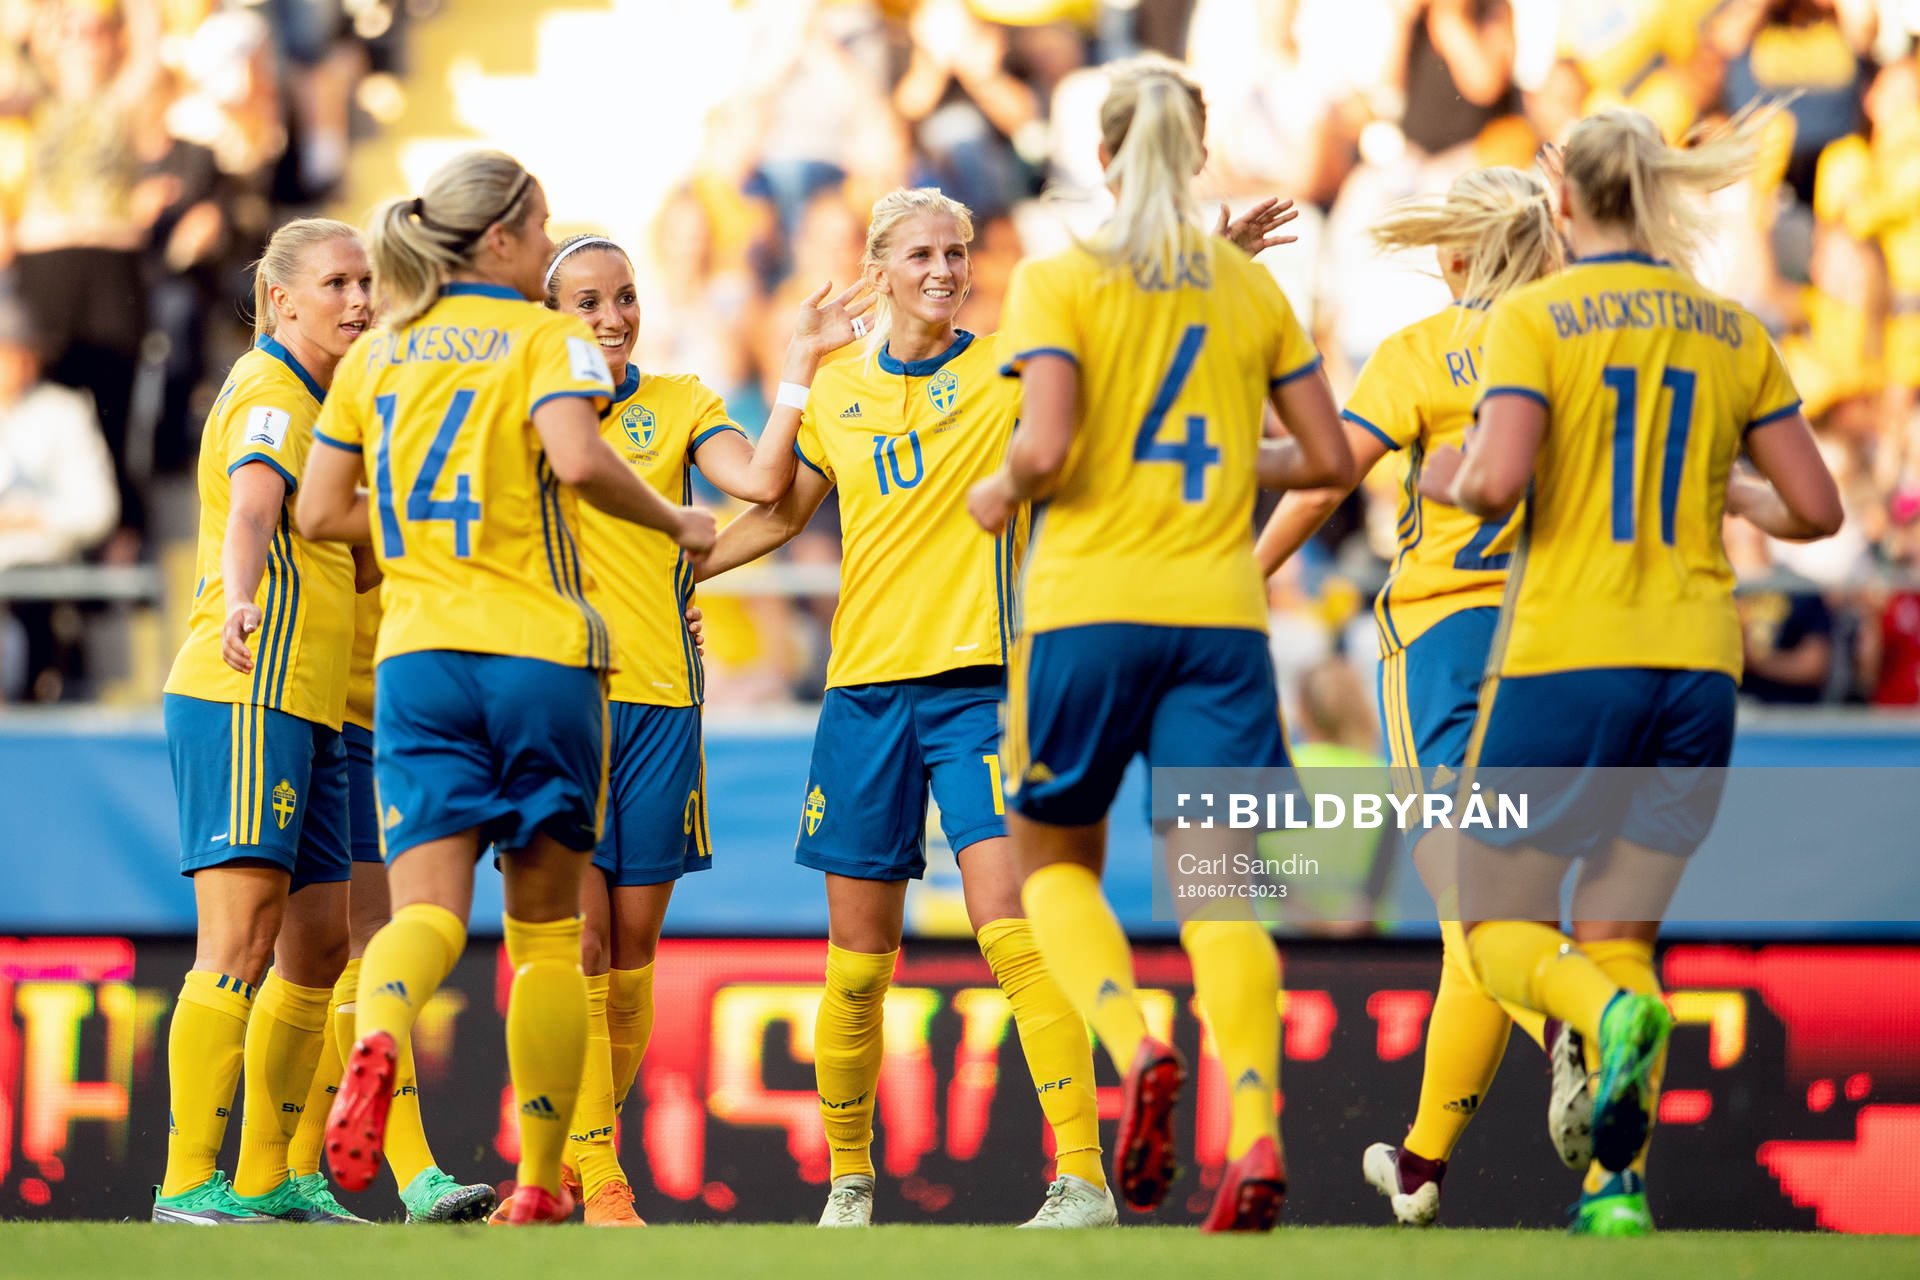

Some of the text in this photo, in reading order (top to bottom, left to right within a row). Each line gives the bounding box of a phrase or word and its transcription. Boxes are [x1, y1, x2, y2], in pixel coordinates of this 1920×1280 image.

[1548, 290, 1743, 350] BLACKSTENIUS
[375, 389, 482, 559] 14
[873, 429, 925, 496] 10
[1133, 324, 1220, 502] 4
[1602, 366, 1697, 546] 11
